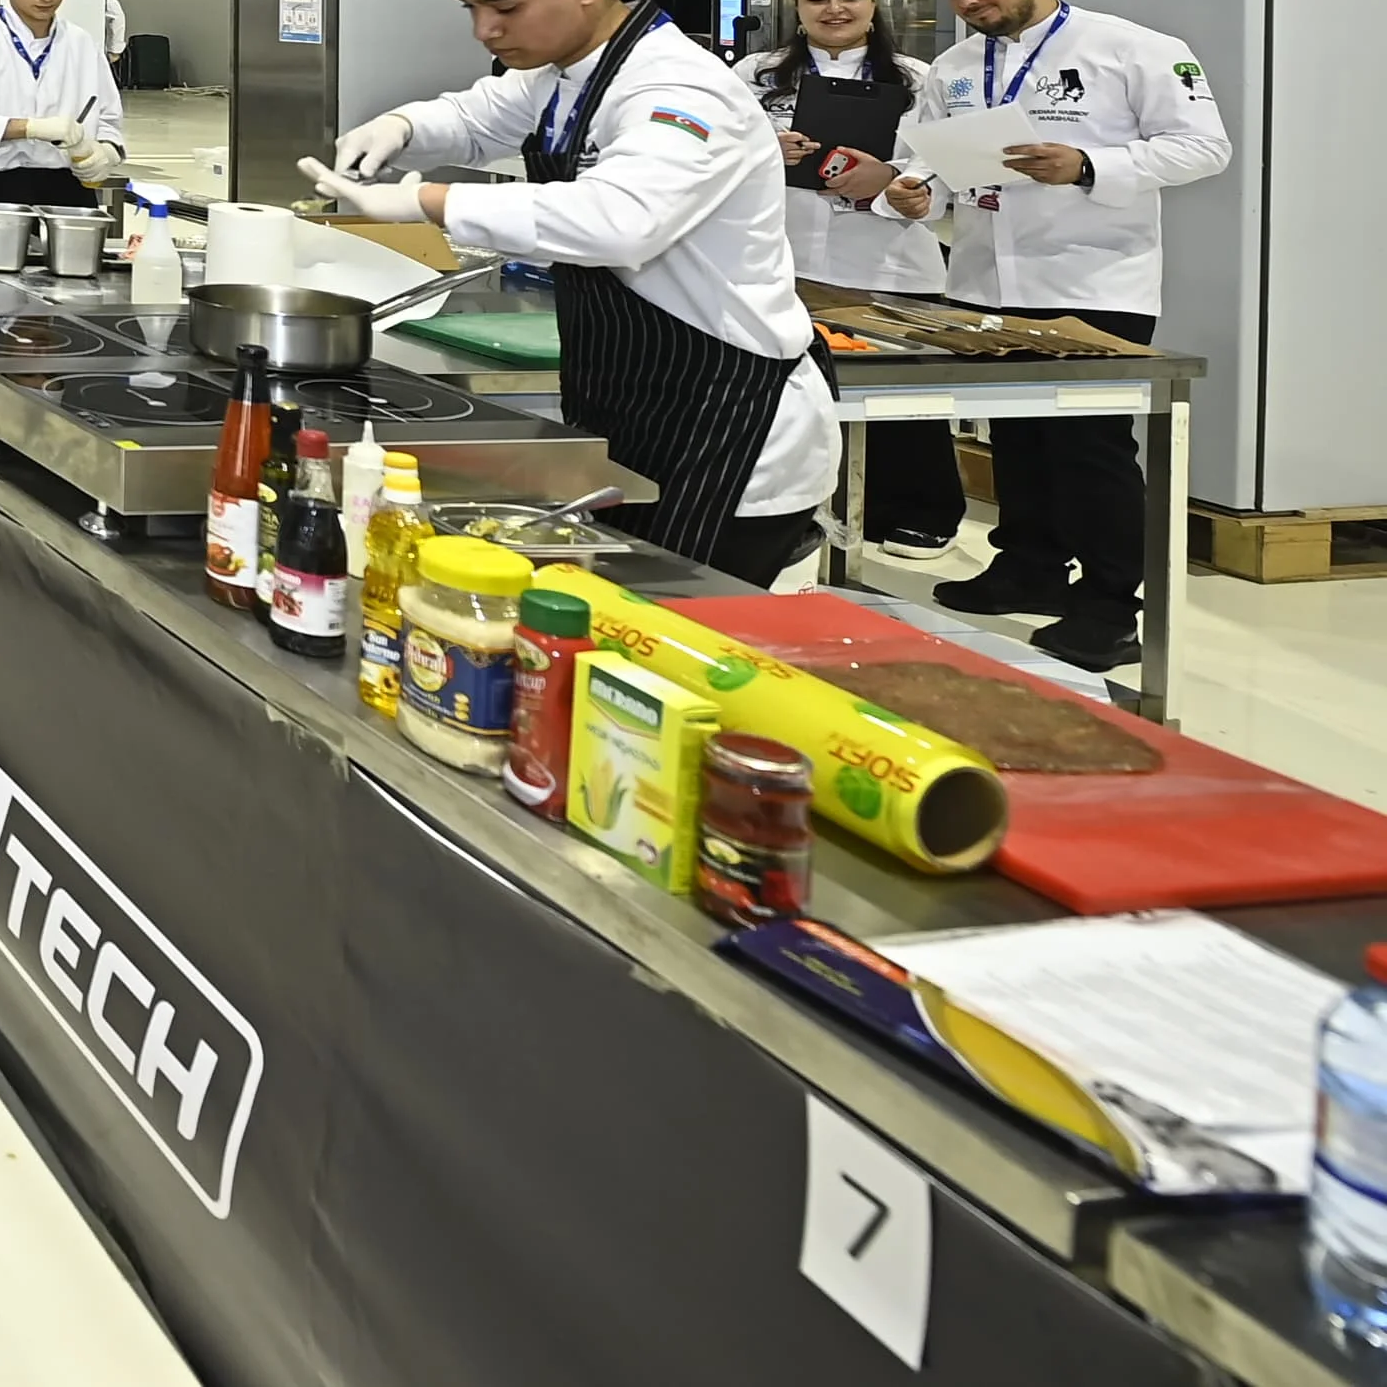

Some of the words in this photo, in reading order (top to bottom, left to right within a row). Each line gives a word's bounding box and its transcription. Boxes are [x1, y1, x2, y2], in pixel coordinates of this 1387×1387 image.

[593, 617, 660, 658] SOFT
[828, 745, 922, 793] SOFT
[838, 1171, 889, 1261] 7
